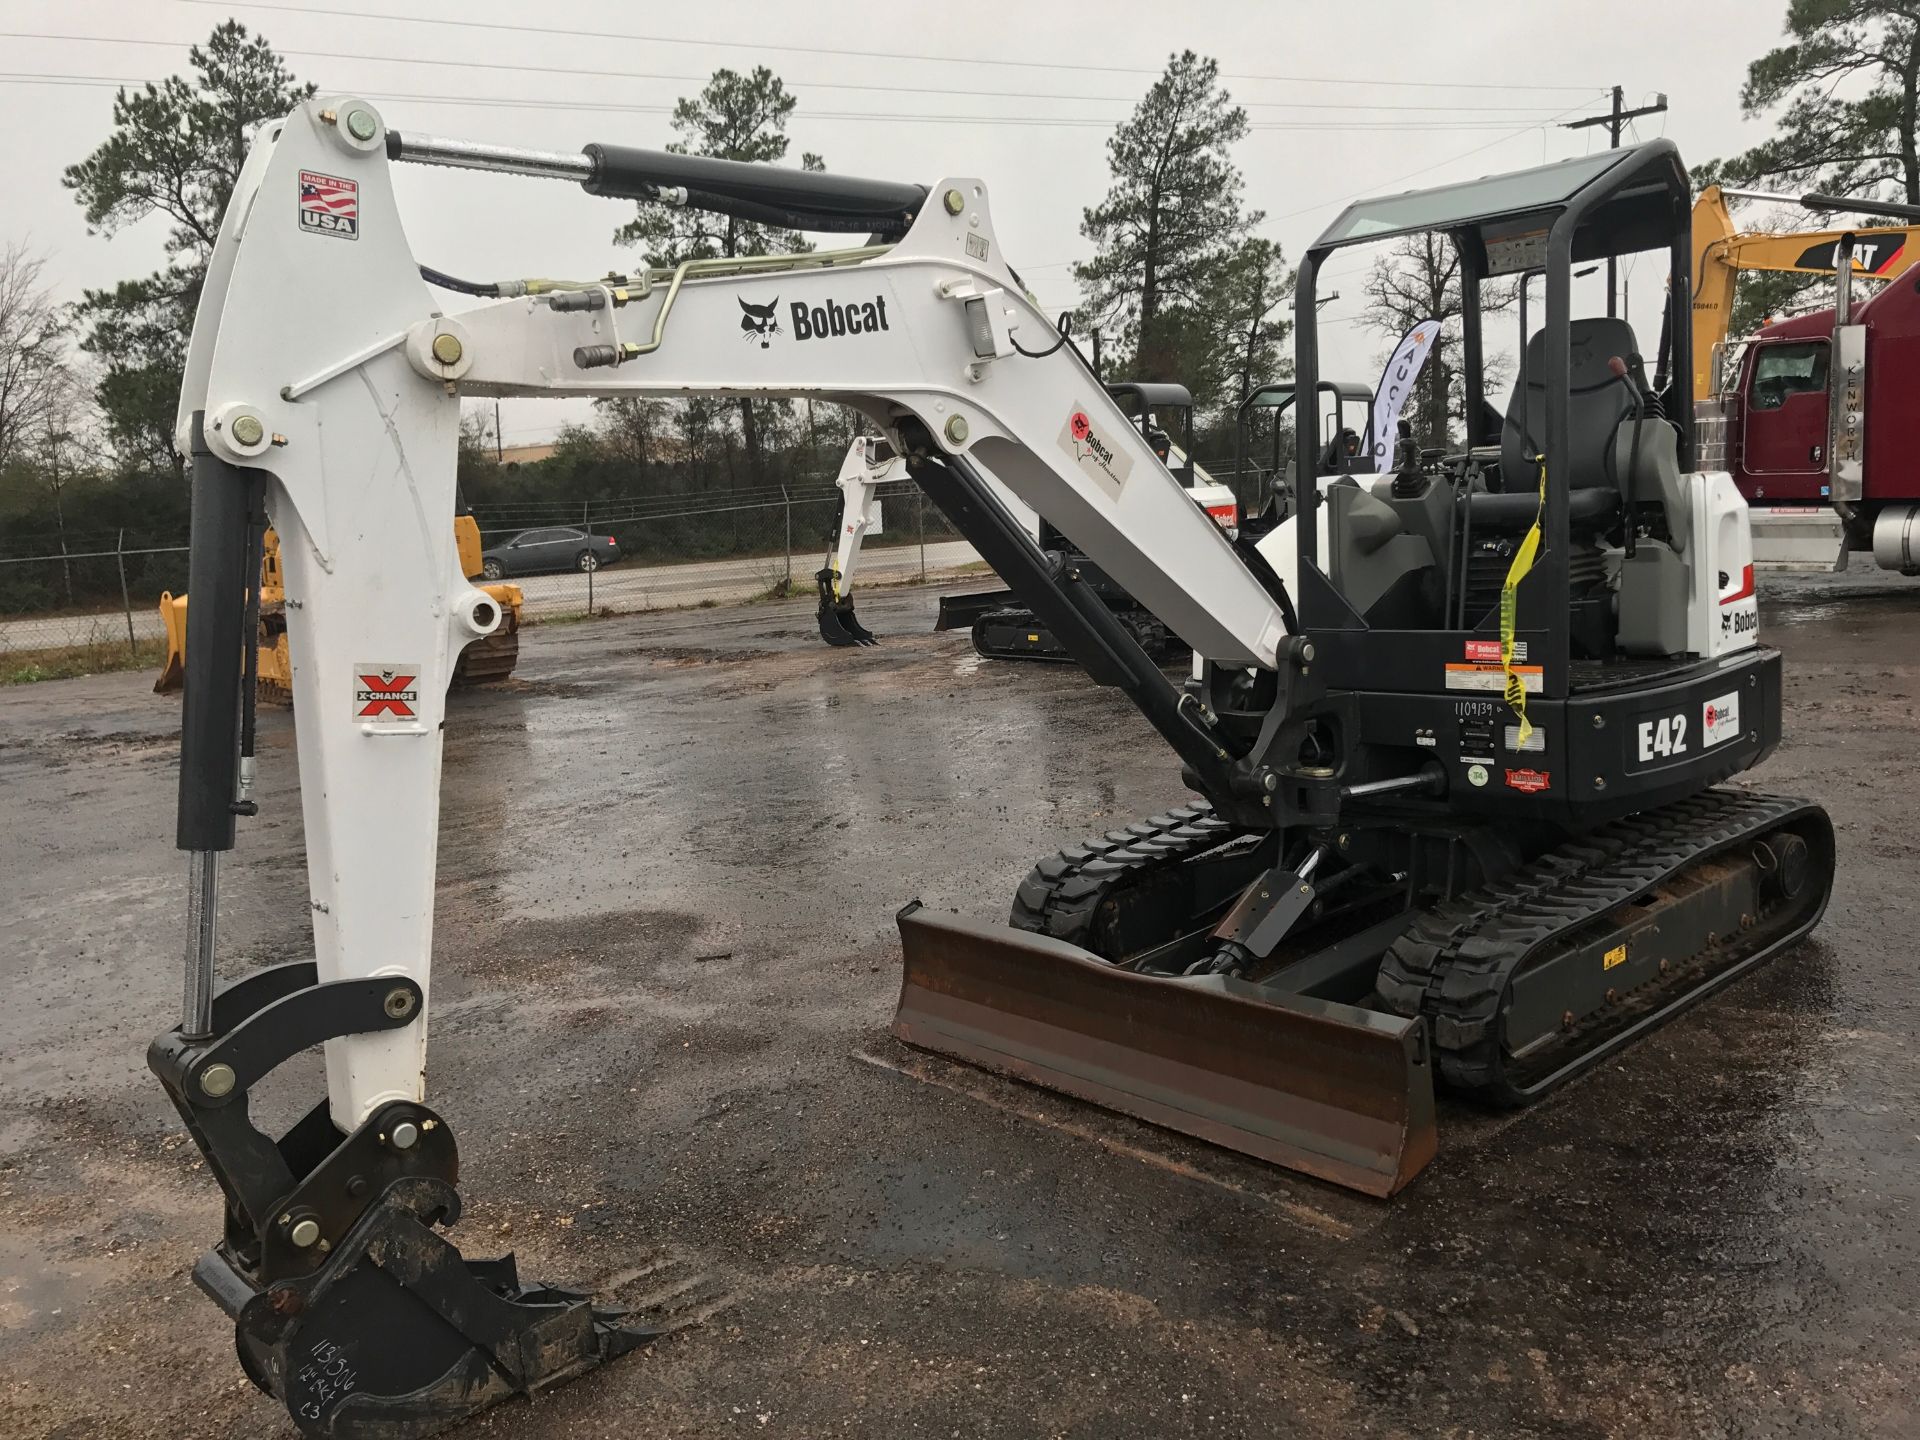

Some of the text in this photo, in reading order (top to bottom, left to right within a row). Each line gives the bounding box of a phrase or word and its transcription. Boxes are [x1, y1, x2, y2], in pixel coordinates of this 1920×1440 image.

[303, 174, 353, 191] MADE IN THE
[304, 211, 353, 233] USA
[790, 295, 890, 341] Bobcat
[1846, 365, 1858, 461] KENWORTH
[1085, 430, 1114, 465] Bobcat
[1734, 610, 1758, 634] Bobca
[1477, 645, 1500, 653] Bobcat
[359, 692, 414, 700] X-CHANGE
[1455, 701, 1493, 717] 1109139
[1638, 714, 1687, 763] E42
[300, 1401, 320, 1419] C3
